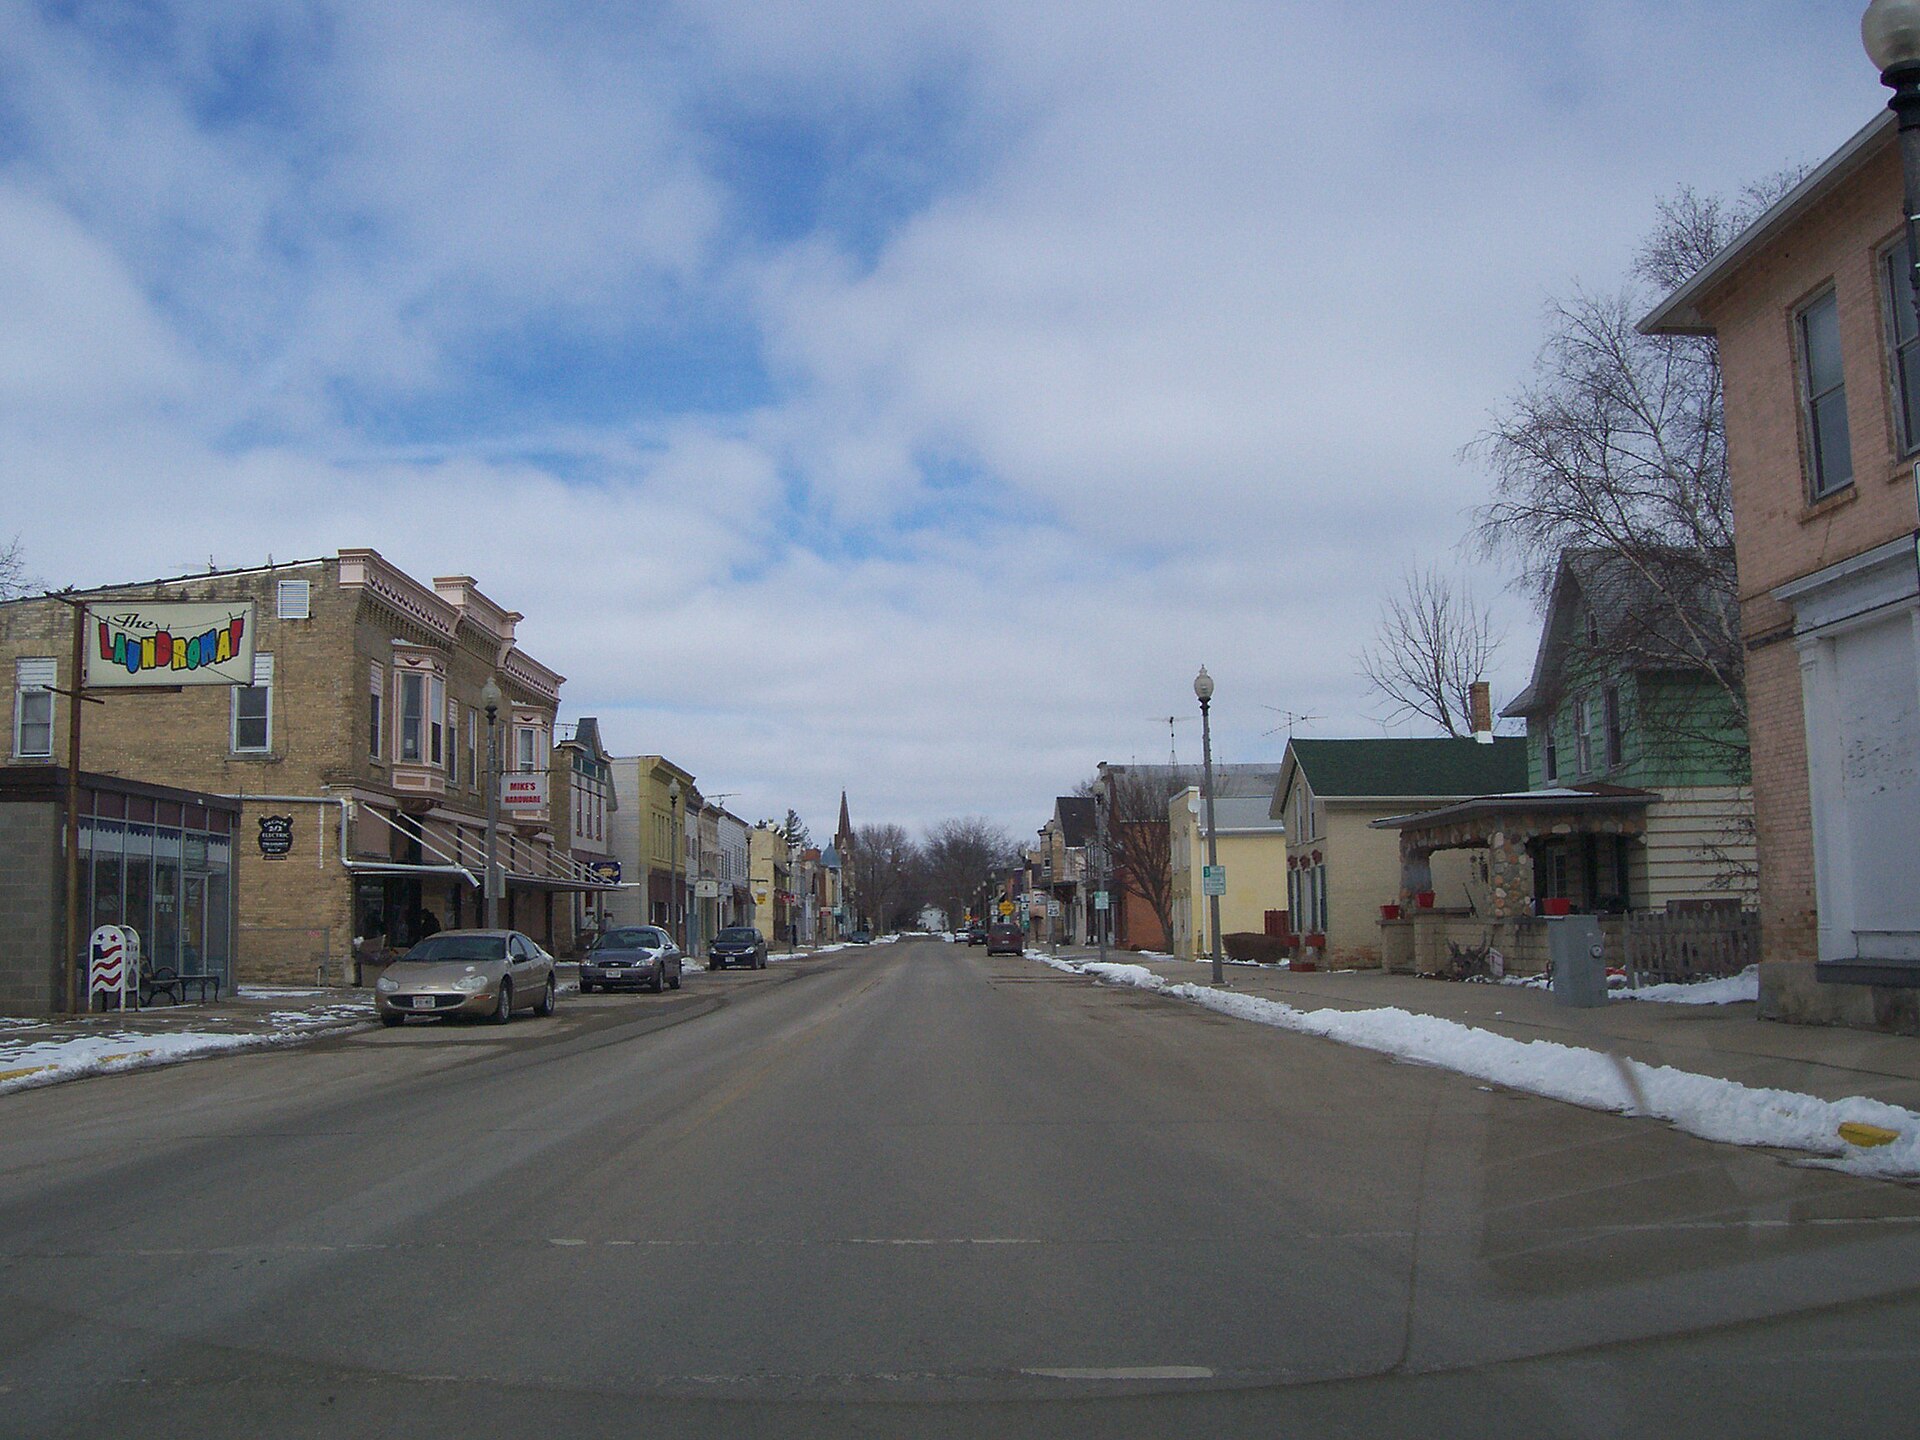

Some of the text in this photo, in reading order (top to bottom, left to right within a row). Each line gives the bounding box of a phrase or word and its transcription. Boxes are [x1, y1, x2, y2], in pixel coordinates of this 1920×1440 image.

[113, 613, 153, 629] The
[98, 617, 245, 674] LAUNDROMAT
[510, 782, 536, 791] MIKE'S
[505, 795, 541, 803] HARDWARE
